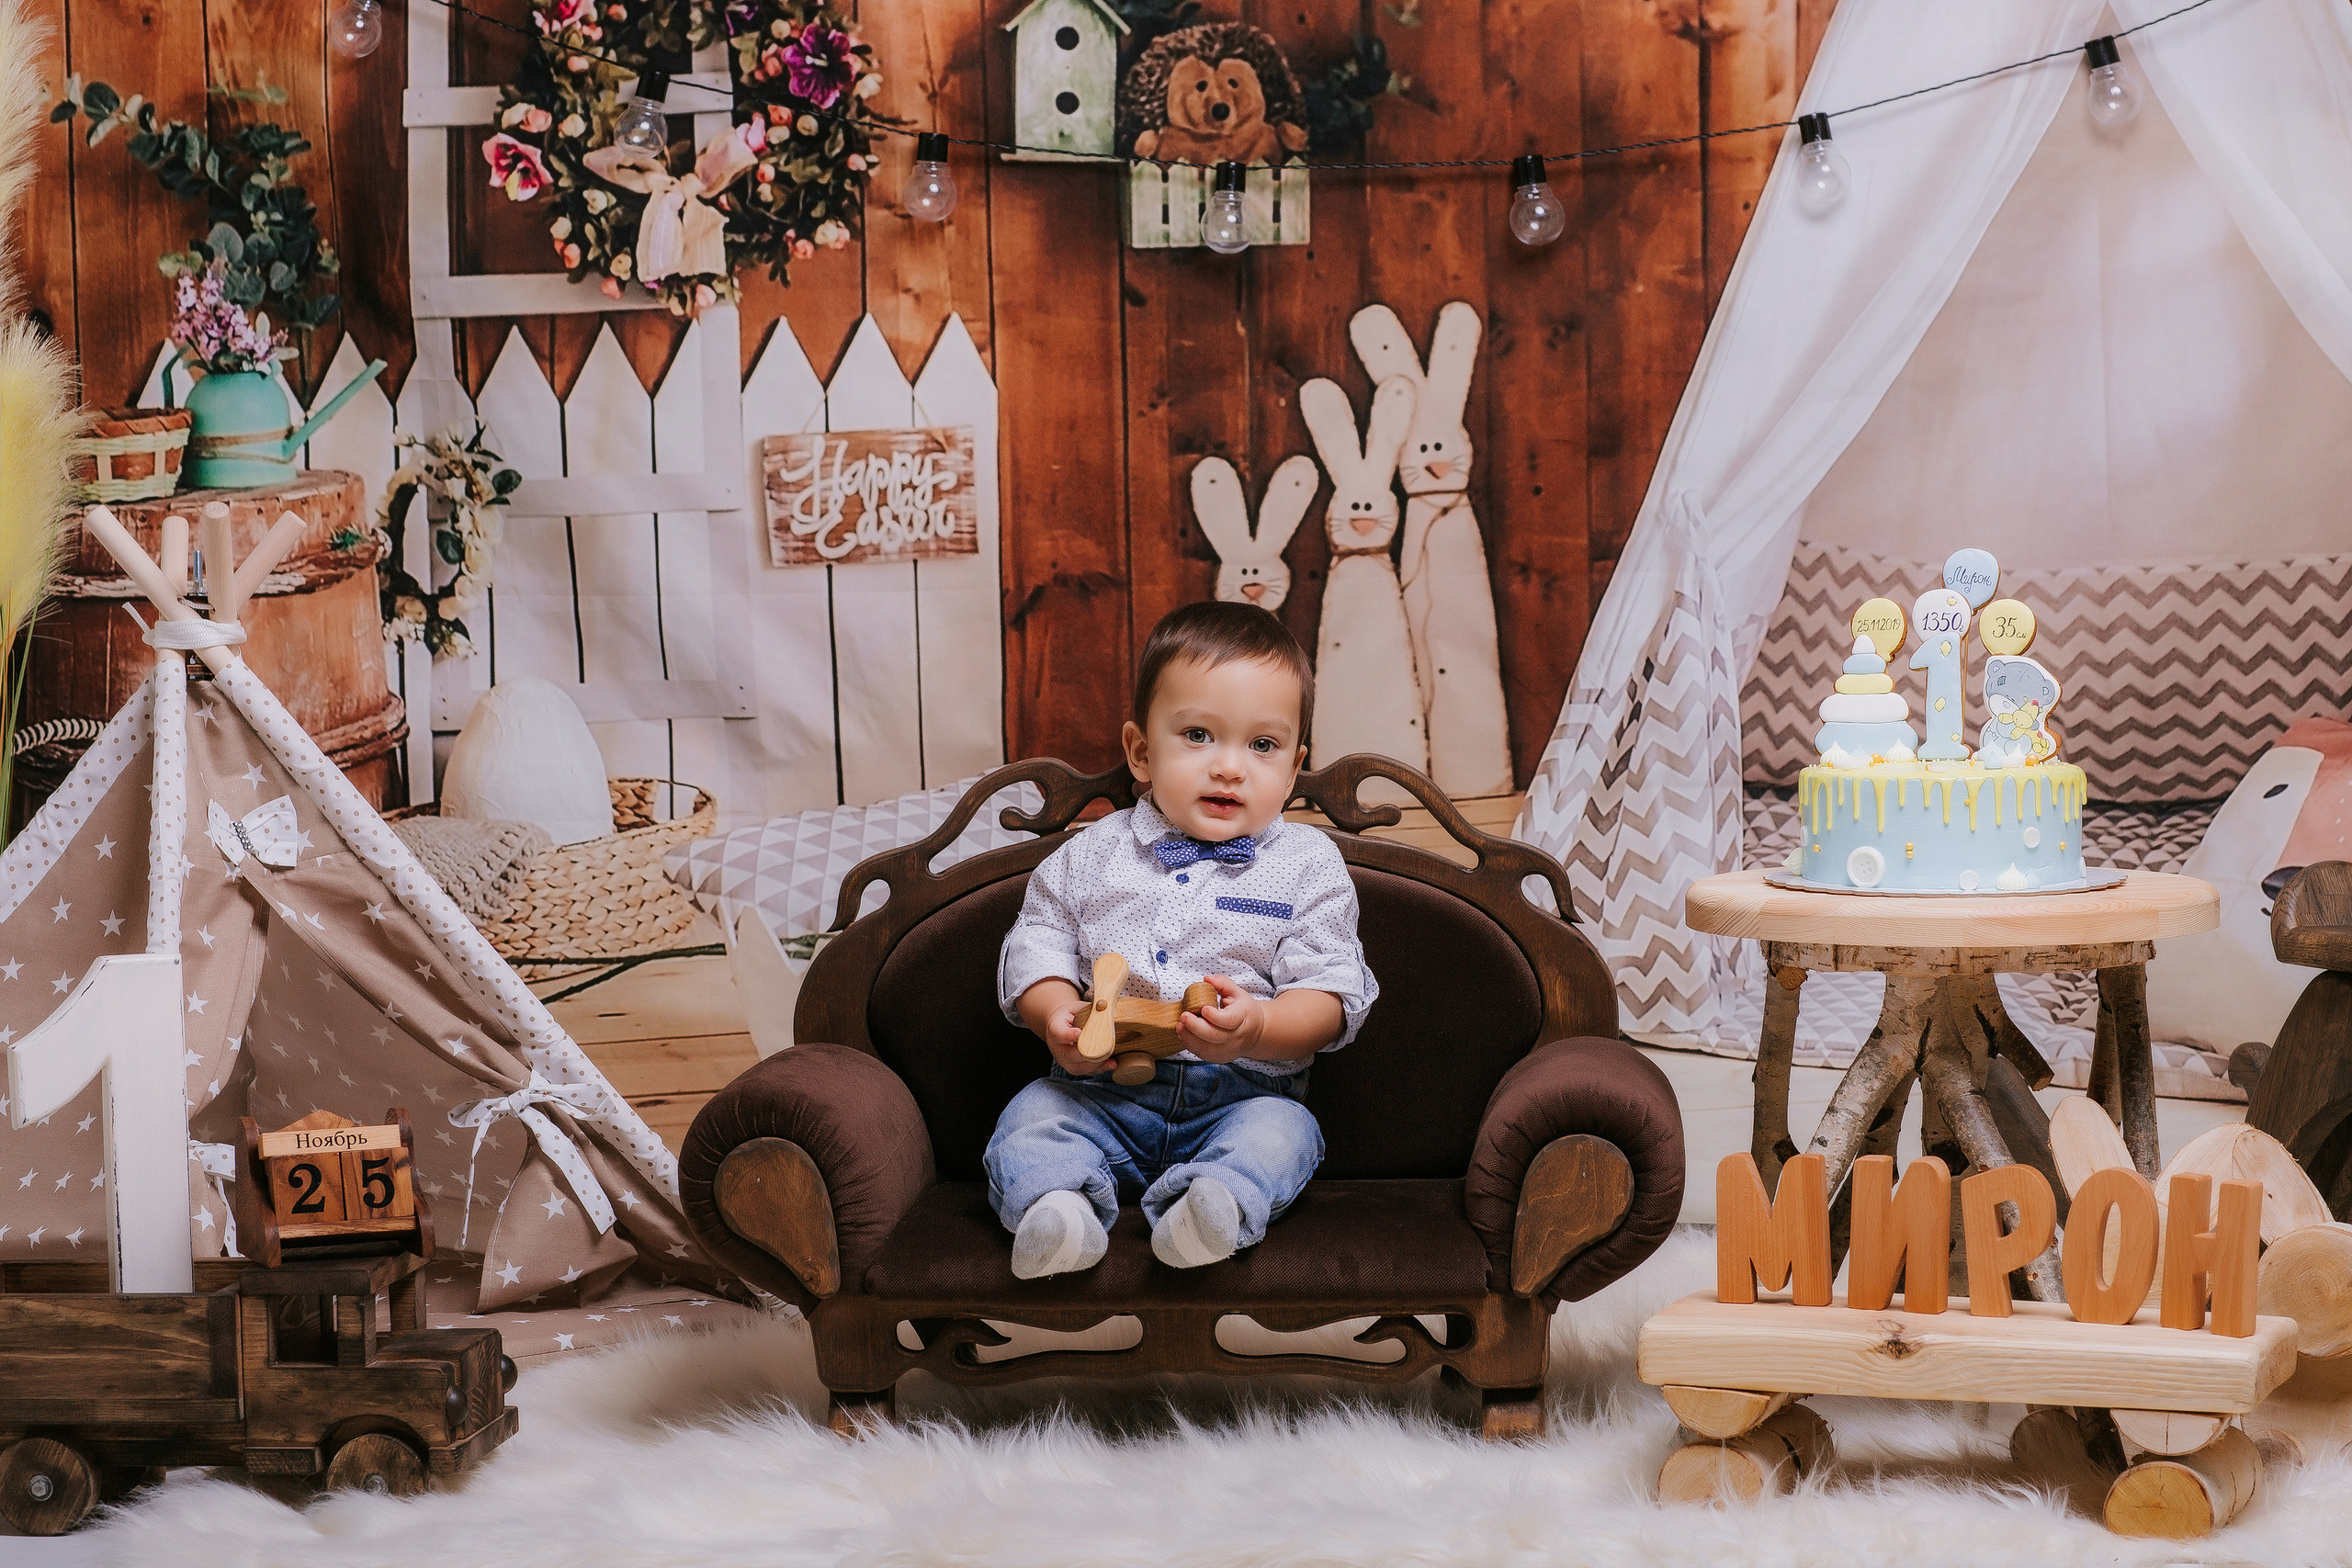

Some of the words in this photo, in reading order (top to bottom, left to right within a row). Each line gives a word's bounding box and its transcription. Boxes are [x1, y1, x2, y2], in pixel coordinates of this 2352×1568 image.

[781, 435, 957, 524] Happy
[791, 489, 956, 558] Easter
[1946, 566, 1992, 593] Мирон
[295, 1131, 368, 1149] Ноябрь
[1716, 1152, 2263, 1337] МИРОН
